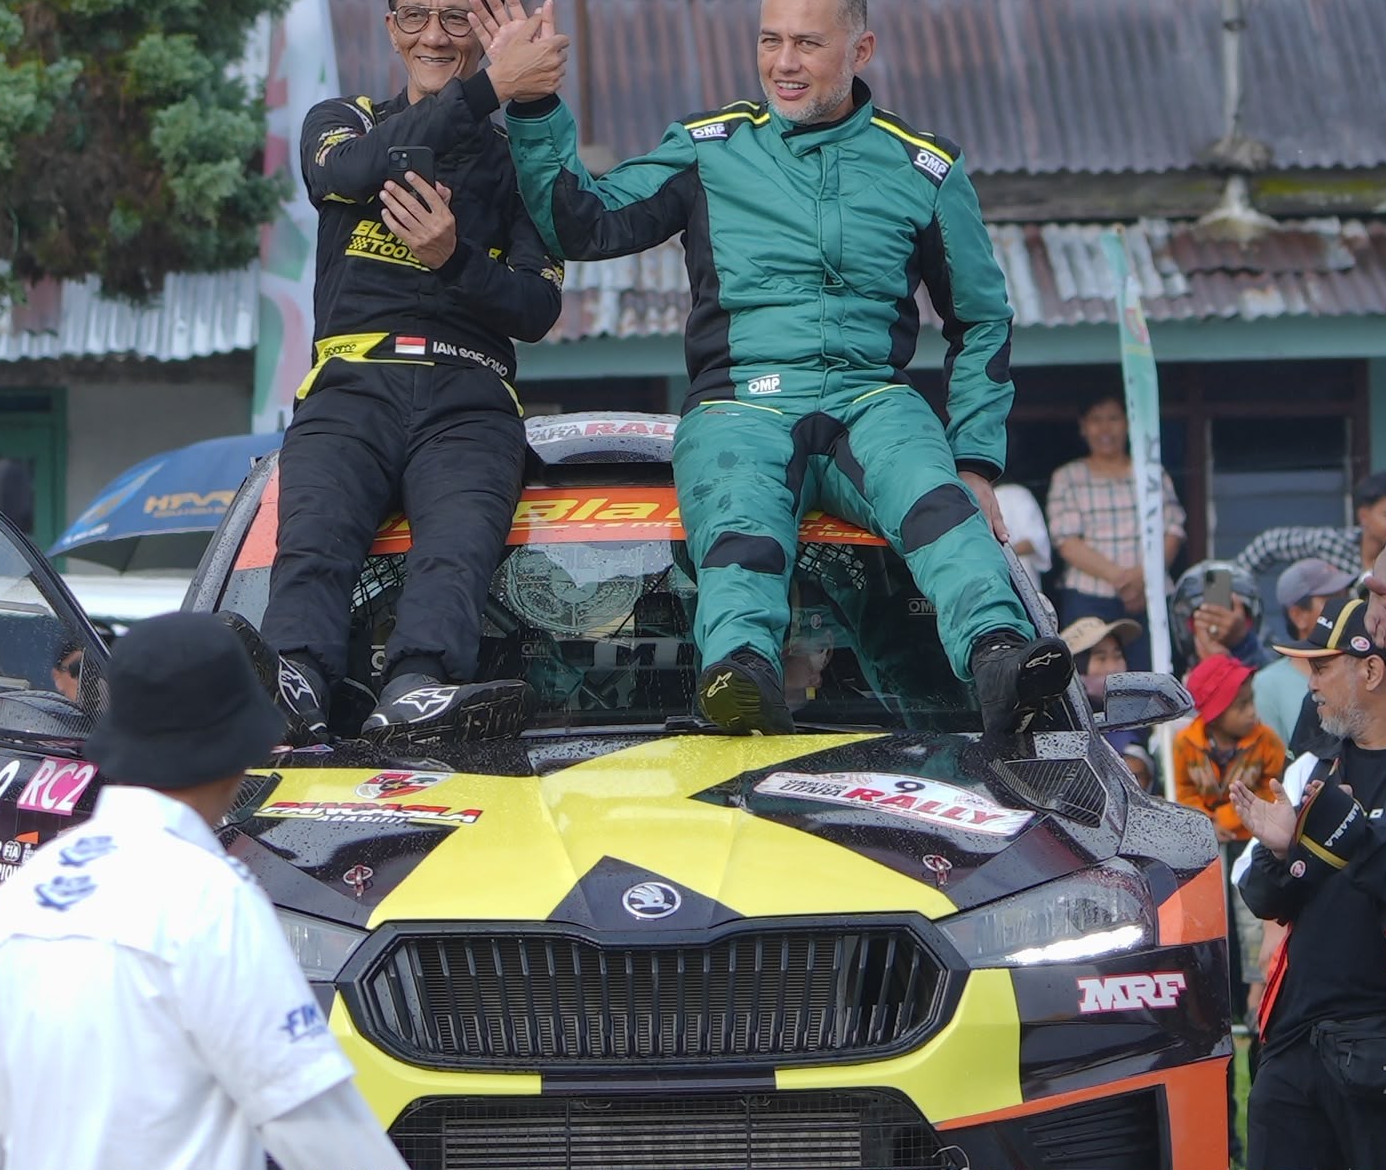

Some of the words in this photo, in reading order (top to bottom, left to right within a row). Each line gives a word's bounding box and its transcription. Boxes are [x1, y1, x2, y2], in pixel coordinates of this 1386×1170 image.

[692, 124, 726, 137] OMP
[916, 152, 948, 176] OMP
[432, 341, 457, 356] IAN
[748, 377, 780, 393] OMP
[584, 422, 675, 436] RAL
[21, 757, 98, 812] RC2
[894, 780, 926, 794] 9
[843, 787, 1005, 825] RALLY
[1077, 973, 1186, 1014] MRF
